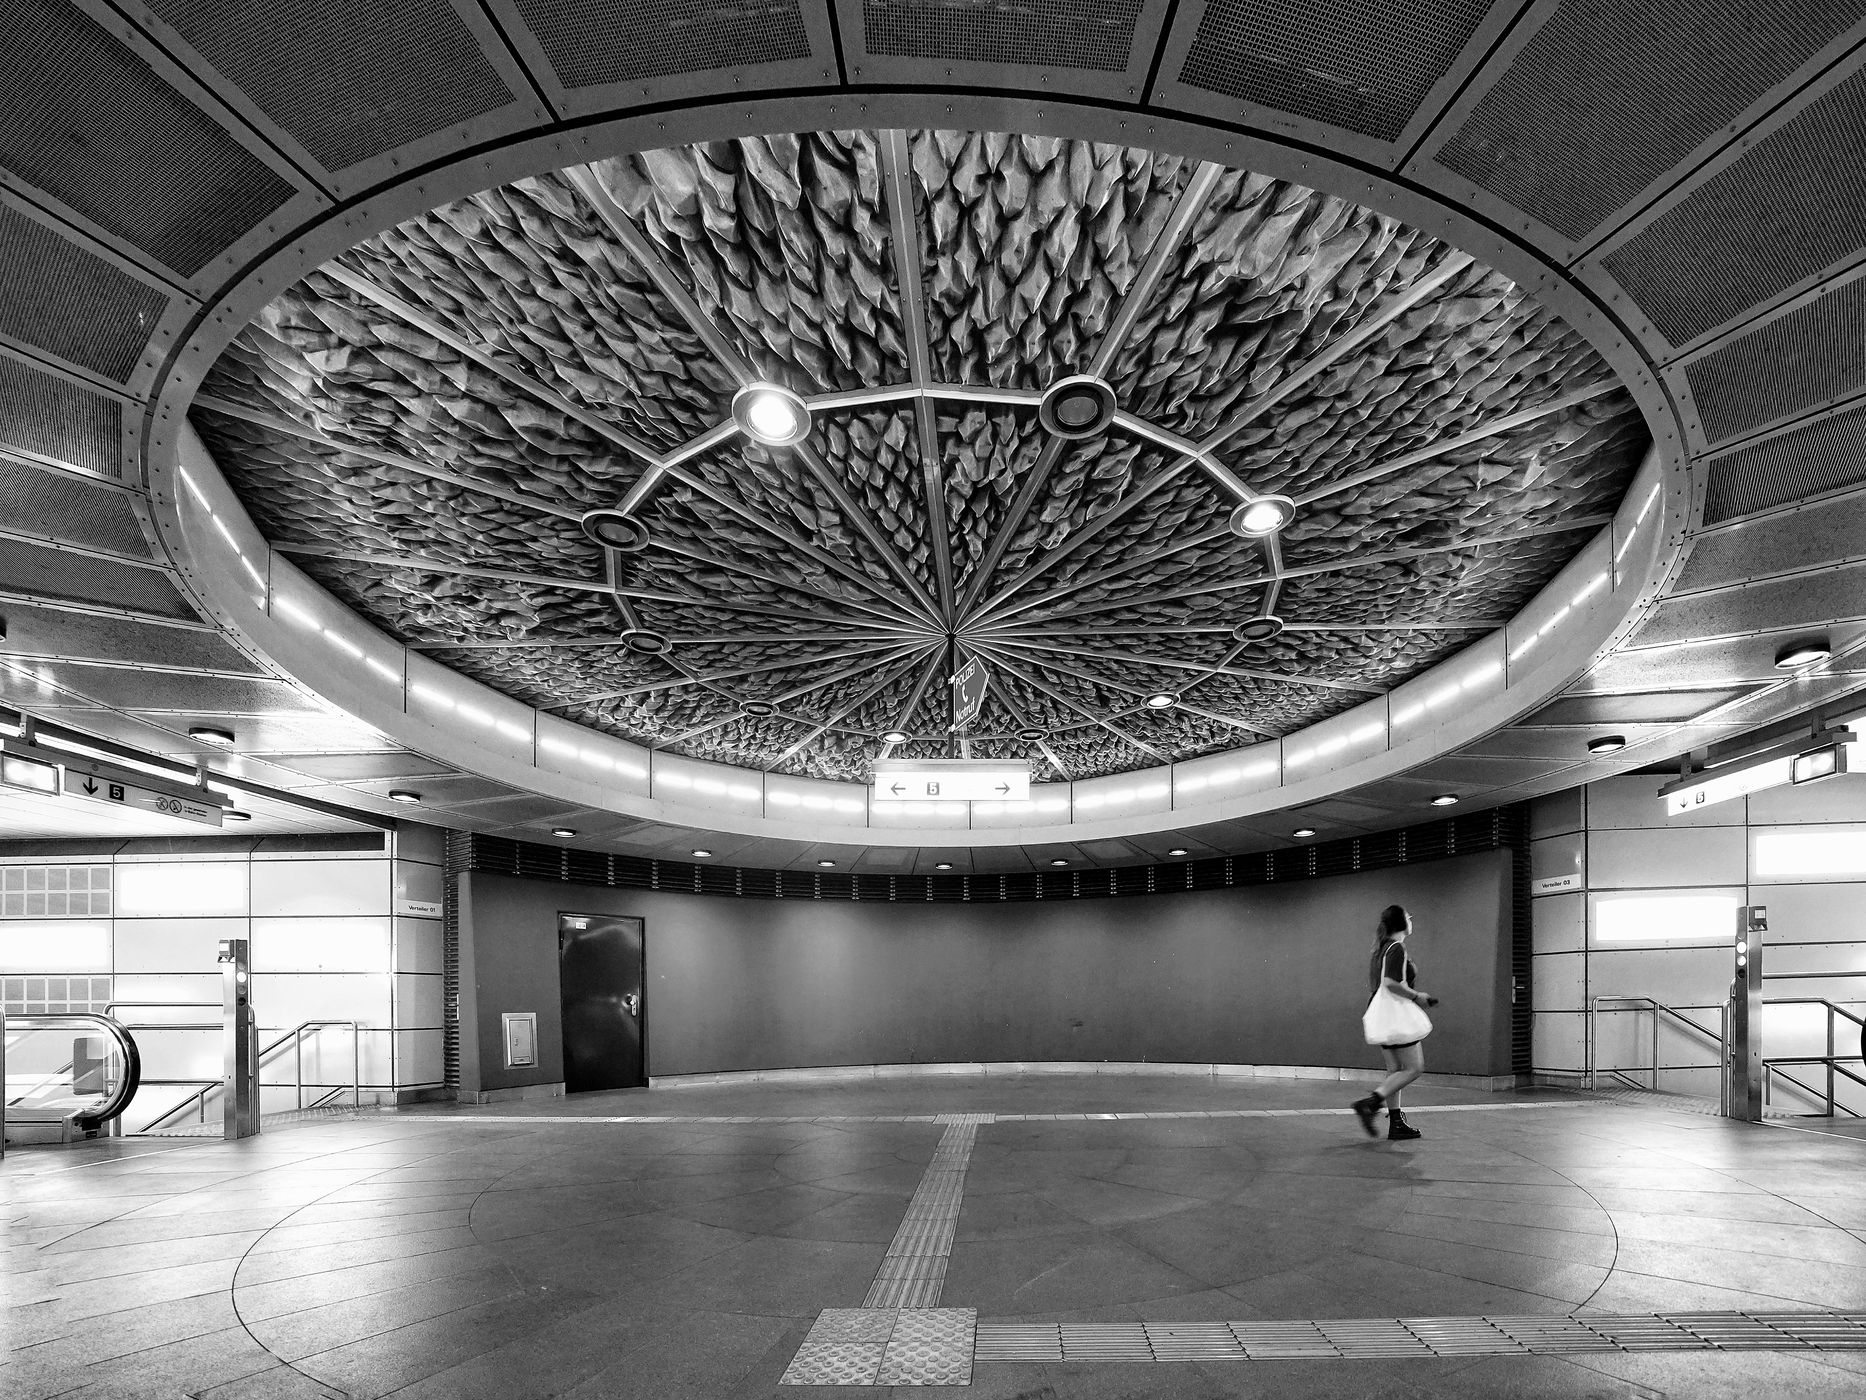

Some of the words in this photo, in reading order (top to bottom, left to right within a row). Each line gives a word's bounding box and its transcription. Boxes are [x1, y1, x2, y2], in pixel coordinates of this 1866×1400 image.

[956, 663, 975, 689] POLIZEI
[956, 697, 975, 724] Notruf
[112, 786, 121, 798] 5
